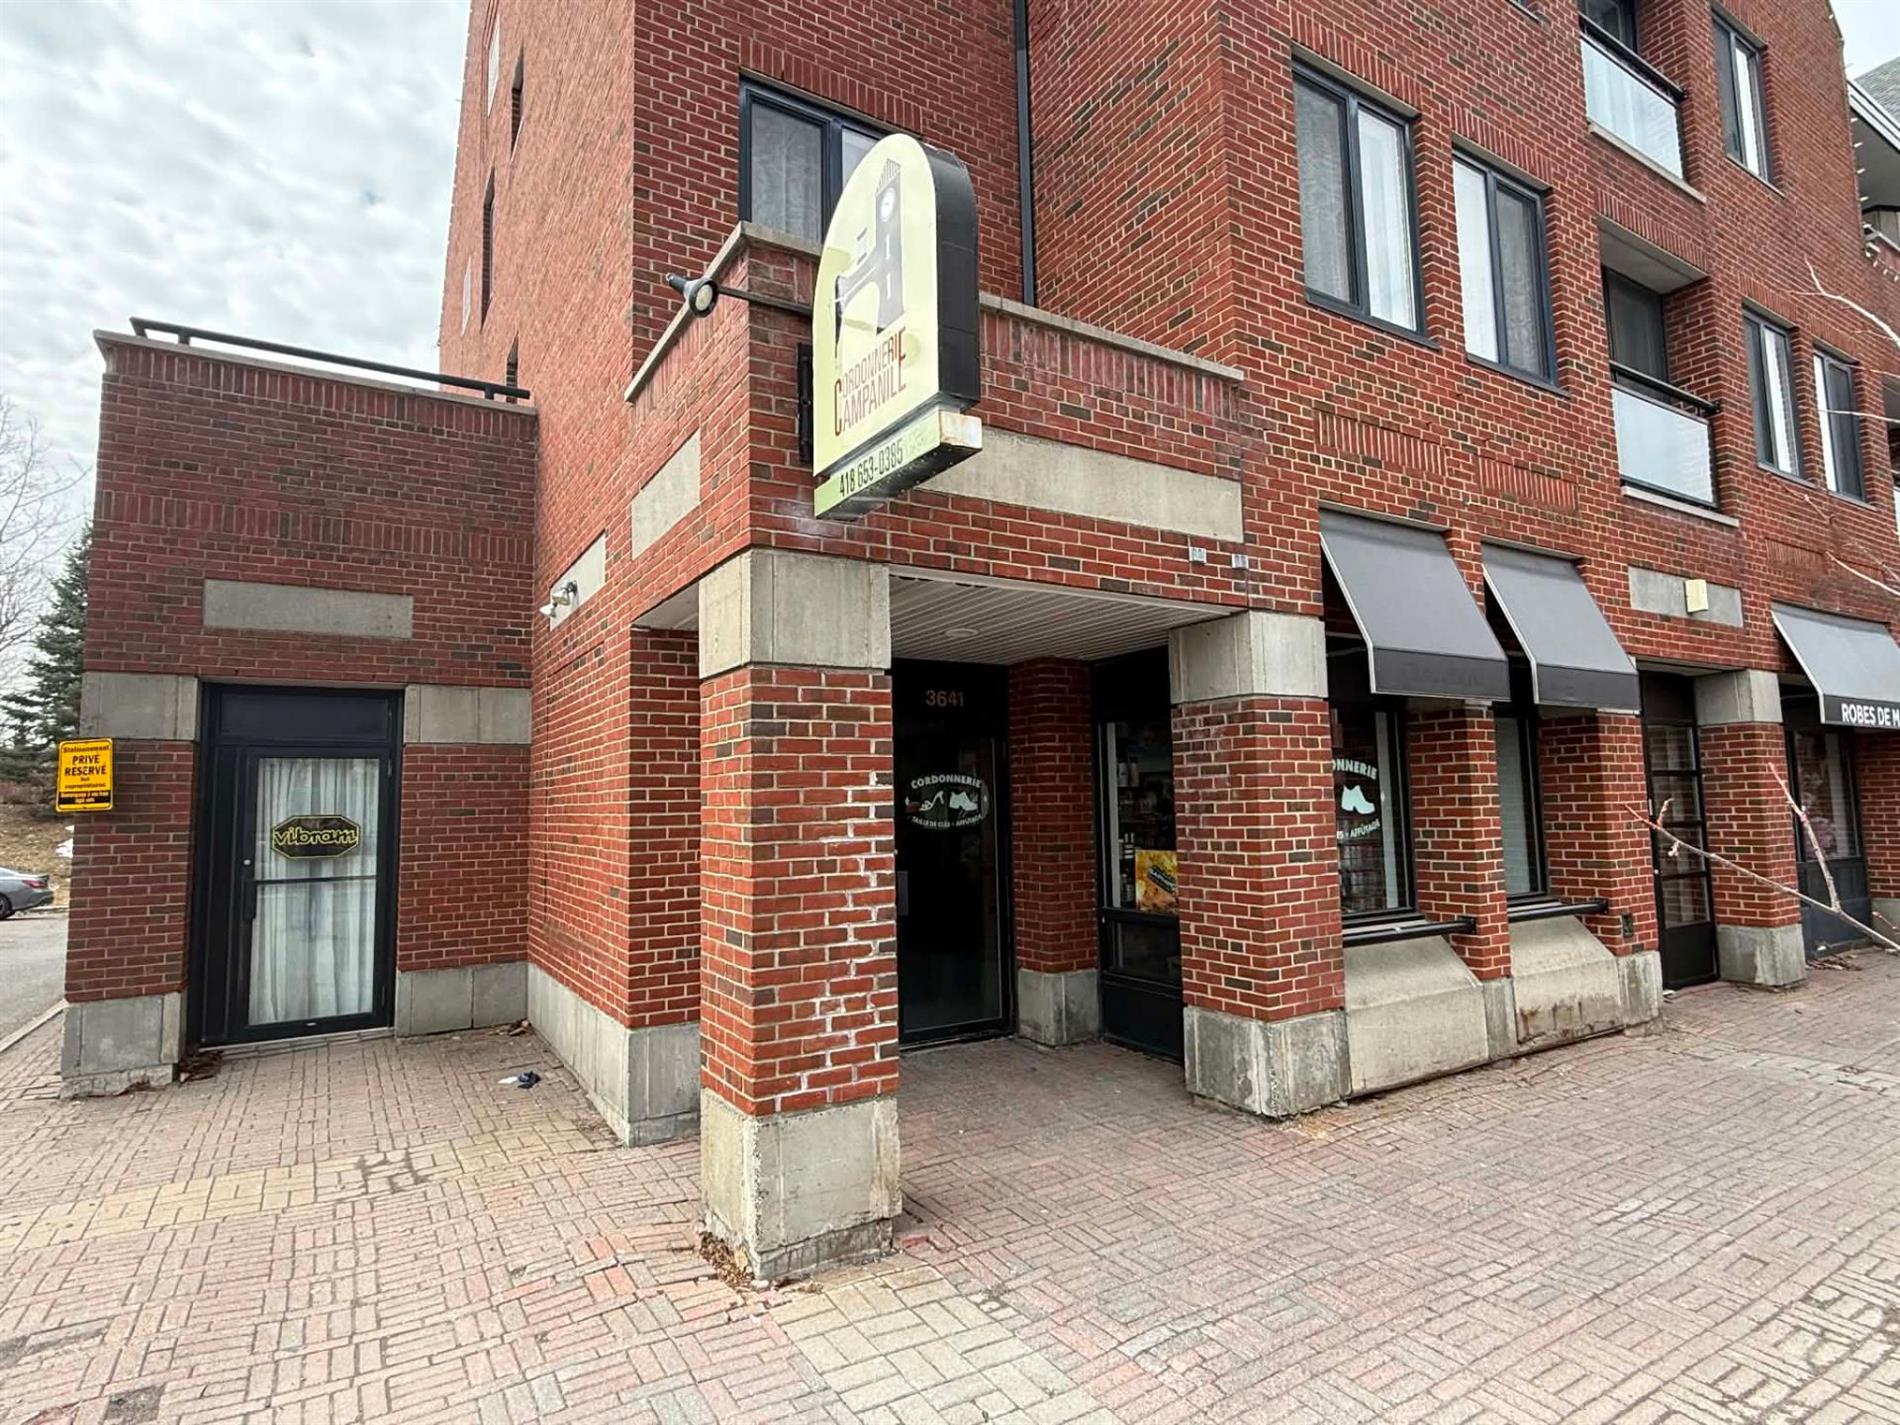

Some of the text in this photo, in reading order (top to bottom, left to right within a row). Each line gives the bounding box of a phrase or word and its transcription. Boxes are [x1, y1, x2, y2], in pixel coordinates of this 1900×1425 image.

[834, 326, 907, 428] CORDONNERIE
[834, 358, 907, 437] CAMPANILE
[839, 468, 856, 497] 418
[926, 689, 964, 707] 3641
[1841, 703, 1876, 725] ROBES
[1877, 706, 1891, 726] DE
[911, 774, 982, 789] CORDONNERIE
[275, 827, 357, 846] vibram
